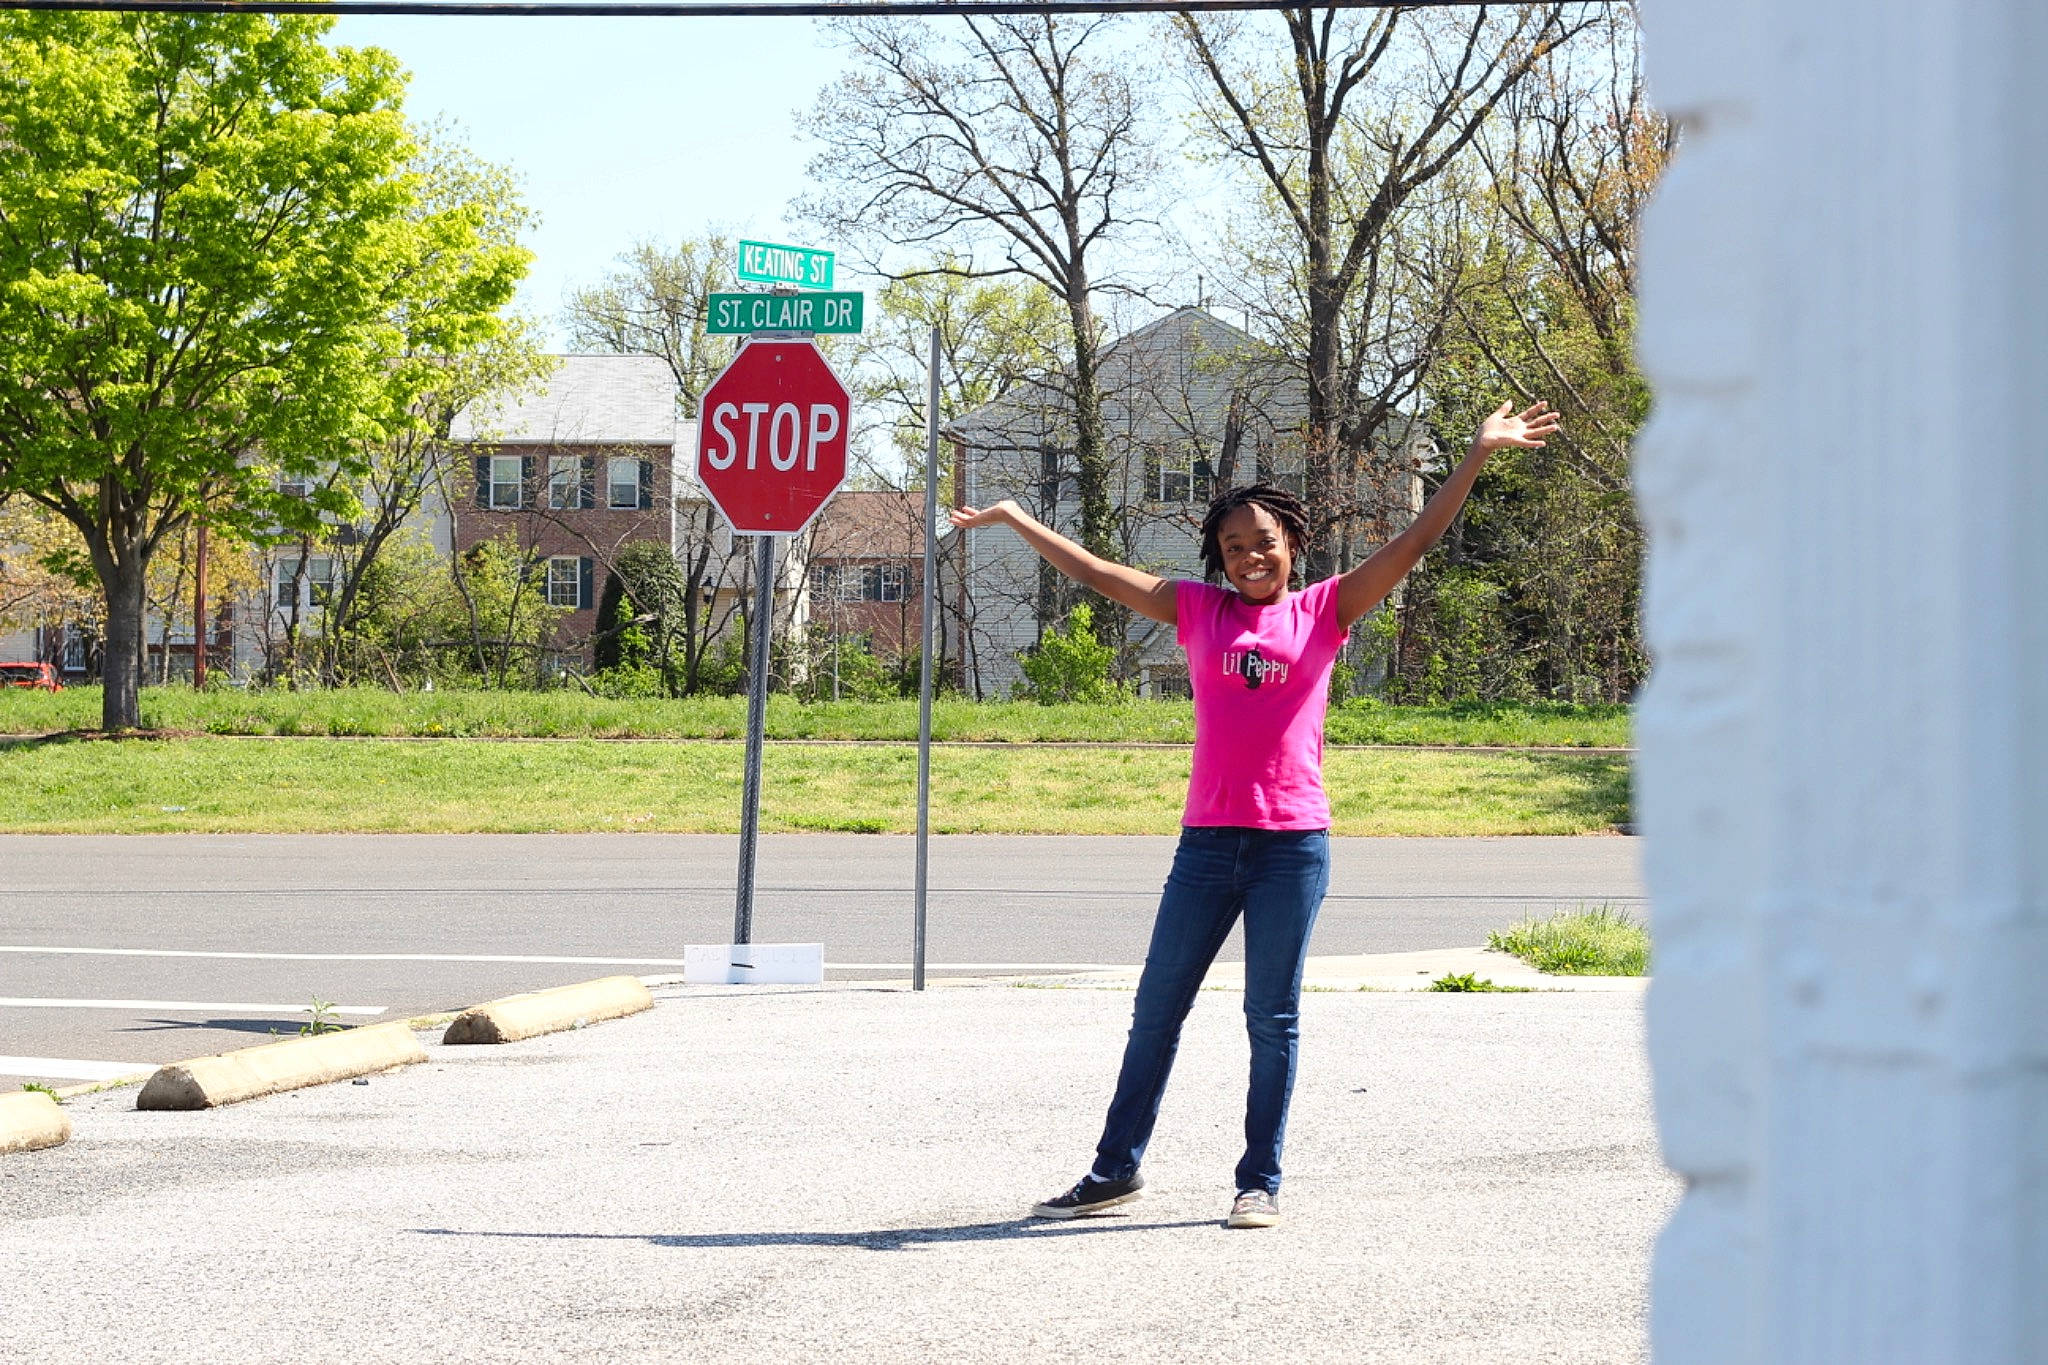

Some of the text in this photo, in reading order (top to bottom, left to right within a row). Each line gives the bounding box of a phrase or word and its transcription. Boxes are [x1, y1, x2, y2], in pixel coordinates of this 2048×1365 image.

[743, 244, 829, 284] KEATING ST
[716, 299, 853, 328] ST. CLAIR DR
[707, 402, 840, 472] STOP
[1222, 652, 1241, 675] Lil
